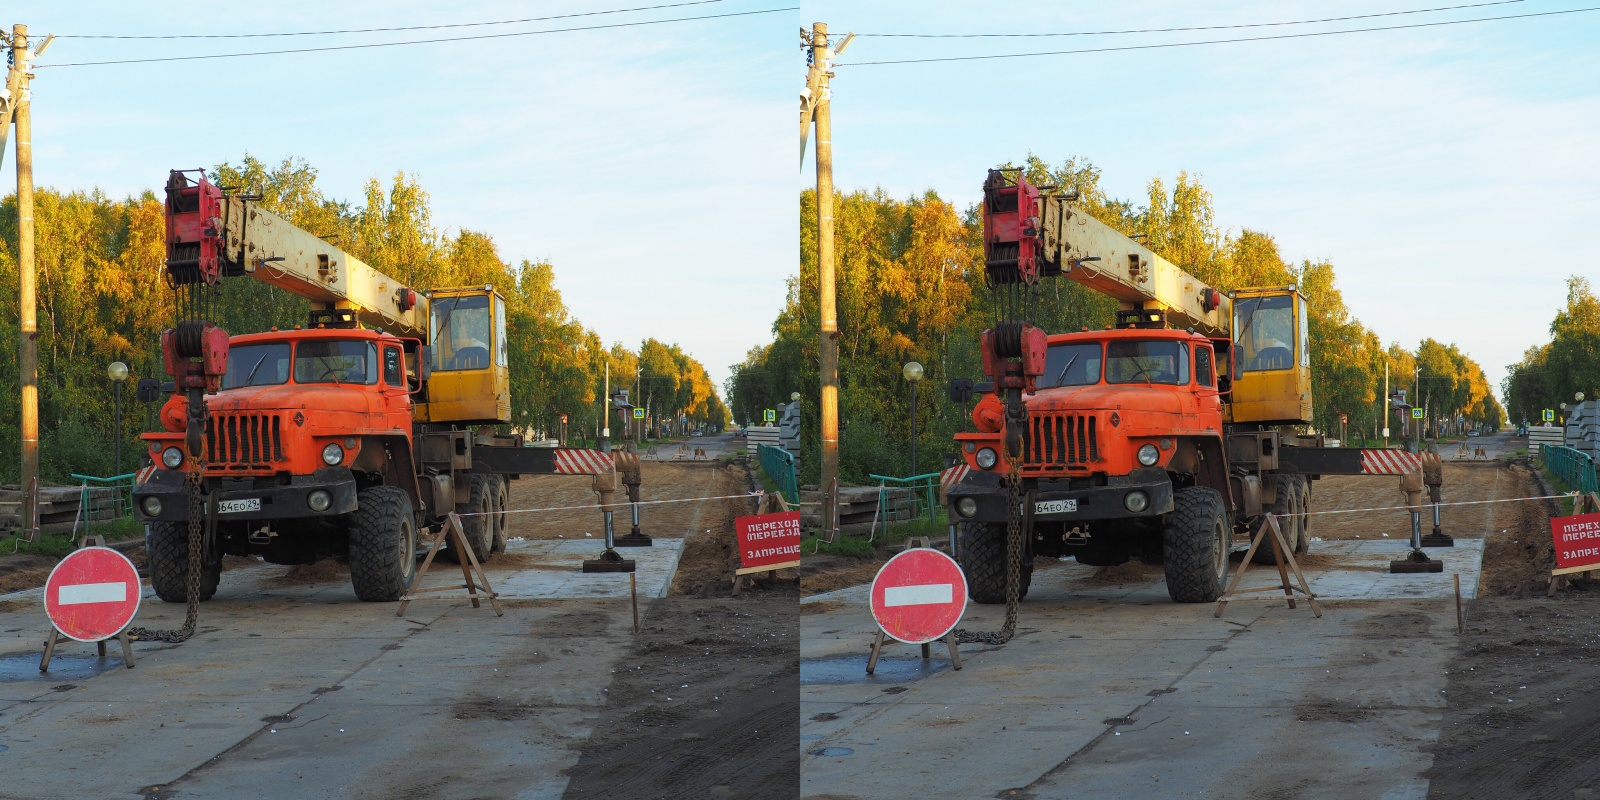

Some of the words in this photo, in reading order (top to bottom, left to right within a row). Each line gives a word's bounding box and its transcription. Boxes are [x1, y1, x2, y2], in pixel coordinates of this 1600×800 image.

[747, 519, 800, 532] ПЕРЕХОД
[1563, 521, 1600, 533] ПЕРЕХ
[1563, 547, 1600, 559] ЗАПРЕ
